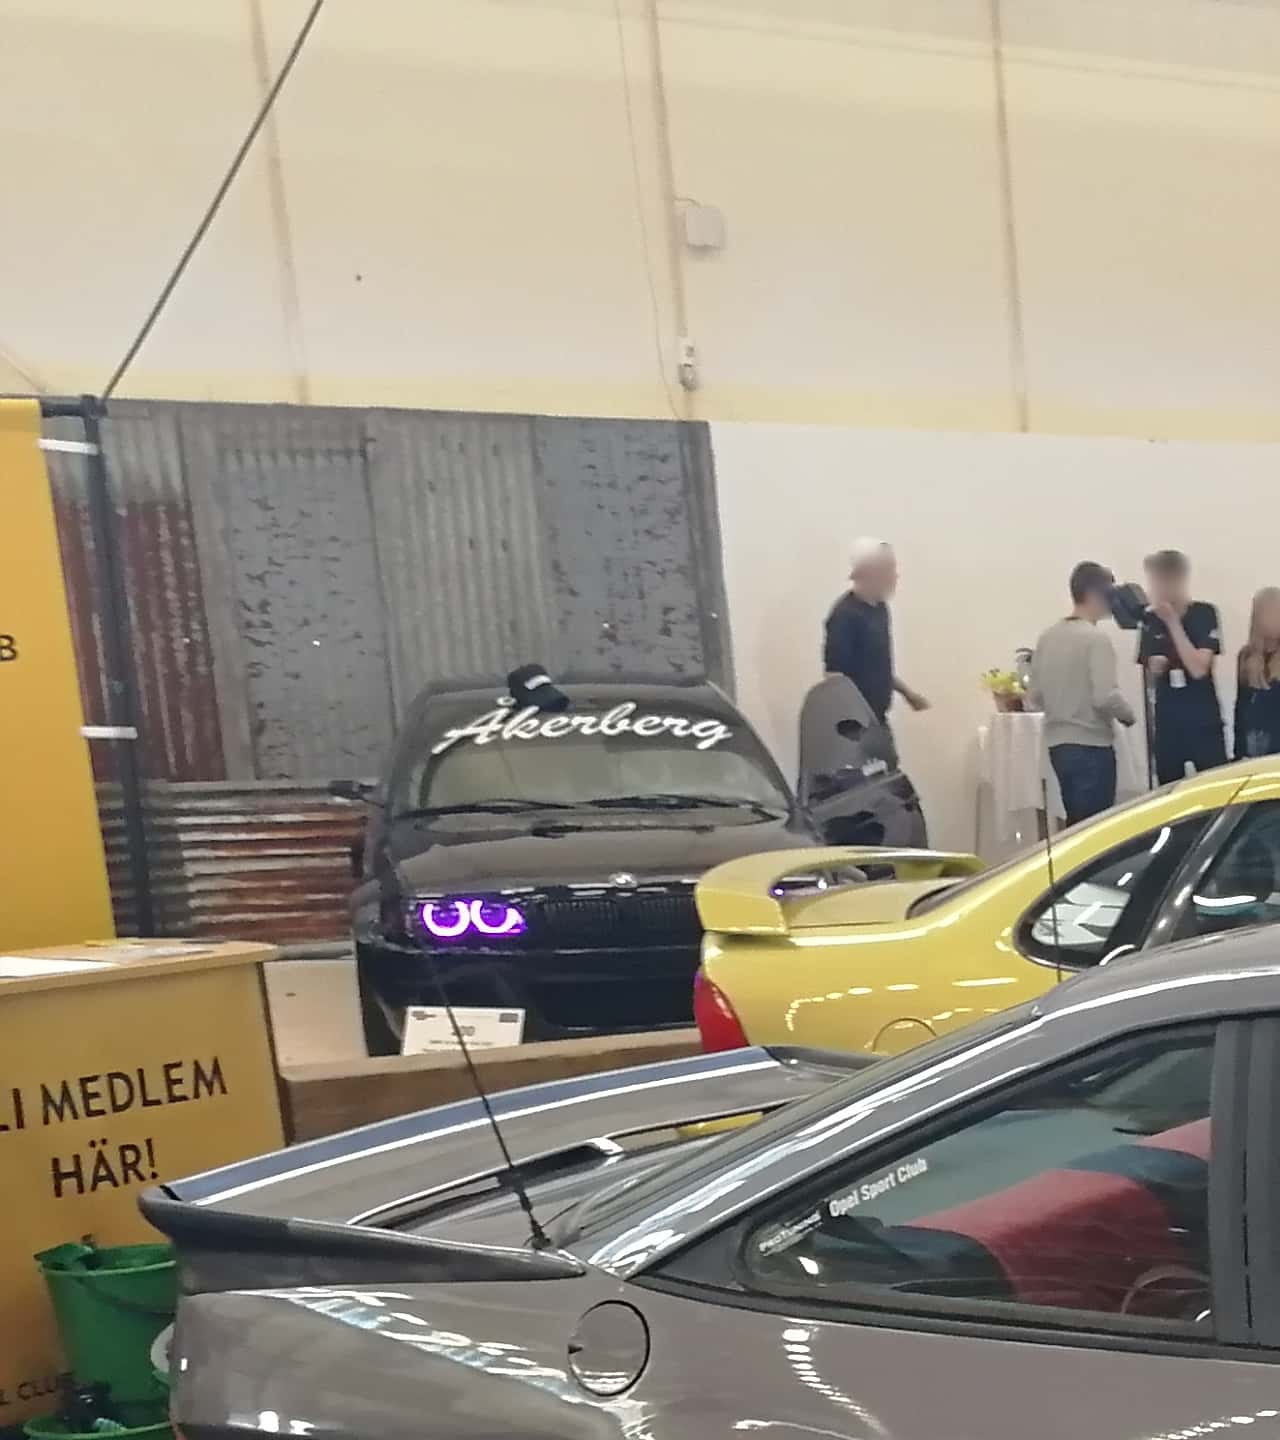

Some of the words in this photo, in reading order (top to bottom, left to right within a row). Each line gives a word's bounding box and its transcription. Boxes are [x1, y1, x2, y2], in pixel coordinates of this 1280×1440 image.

[431, 696, 734, 755] Åkerberg
[40, 1055, 229, 1126] MEDLEM
[51, 1137, 159, 1198] HÄR!
[829, 1189, 860, 1218] Opel
[860, 1172, 897, 1201] Sport
[897, 1157, 929, 1183] Club
